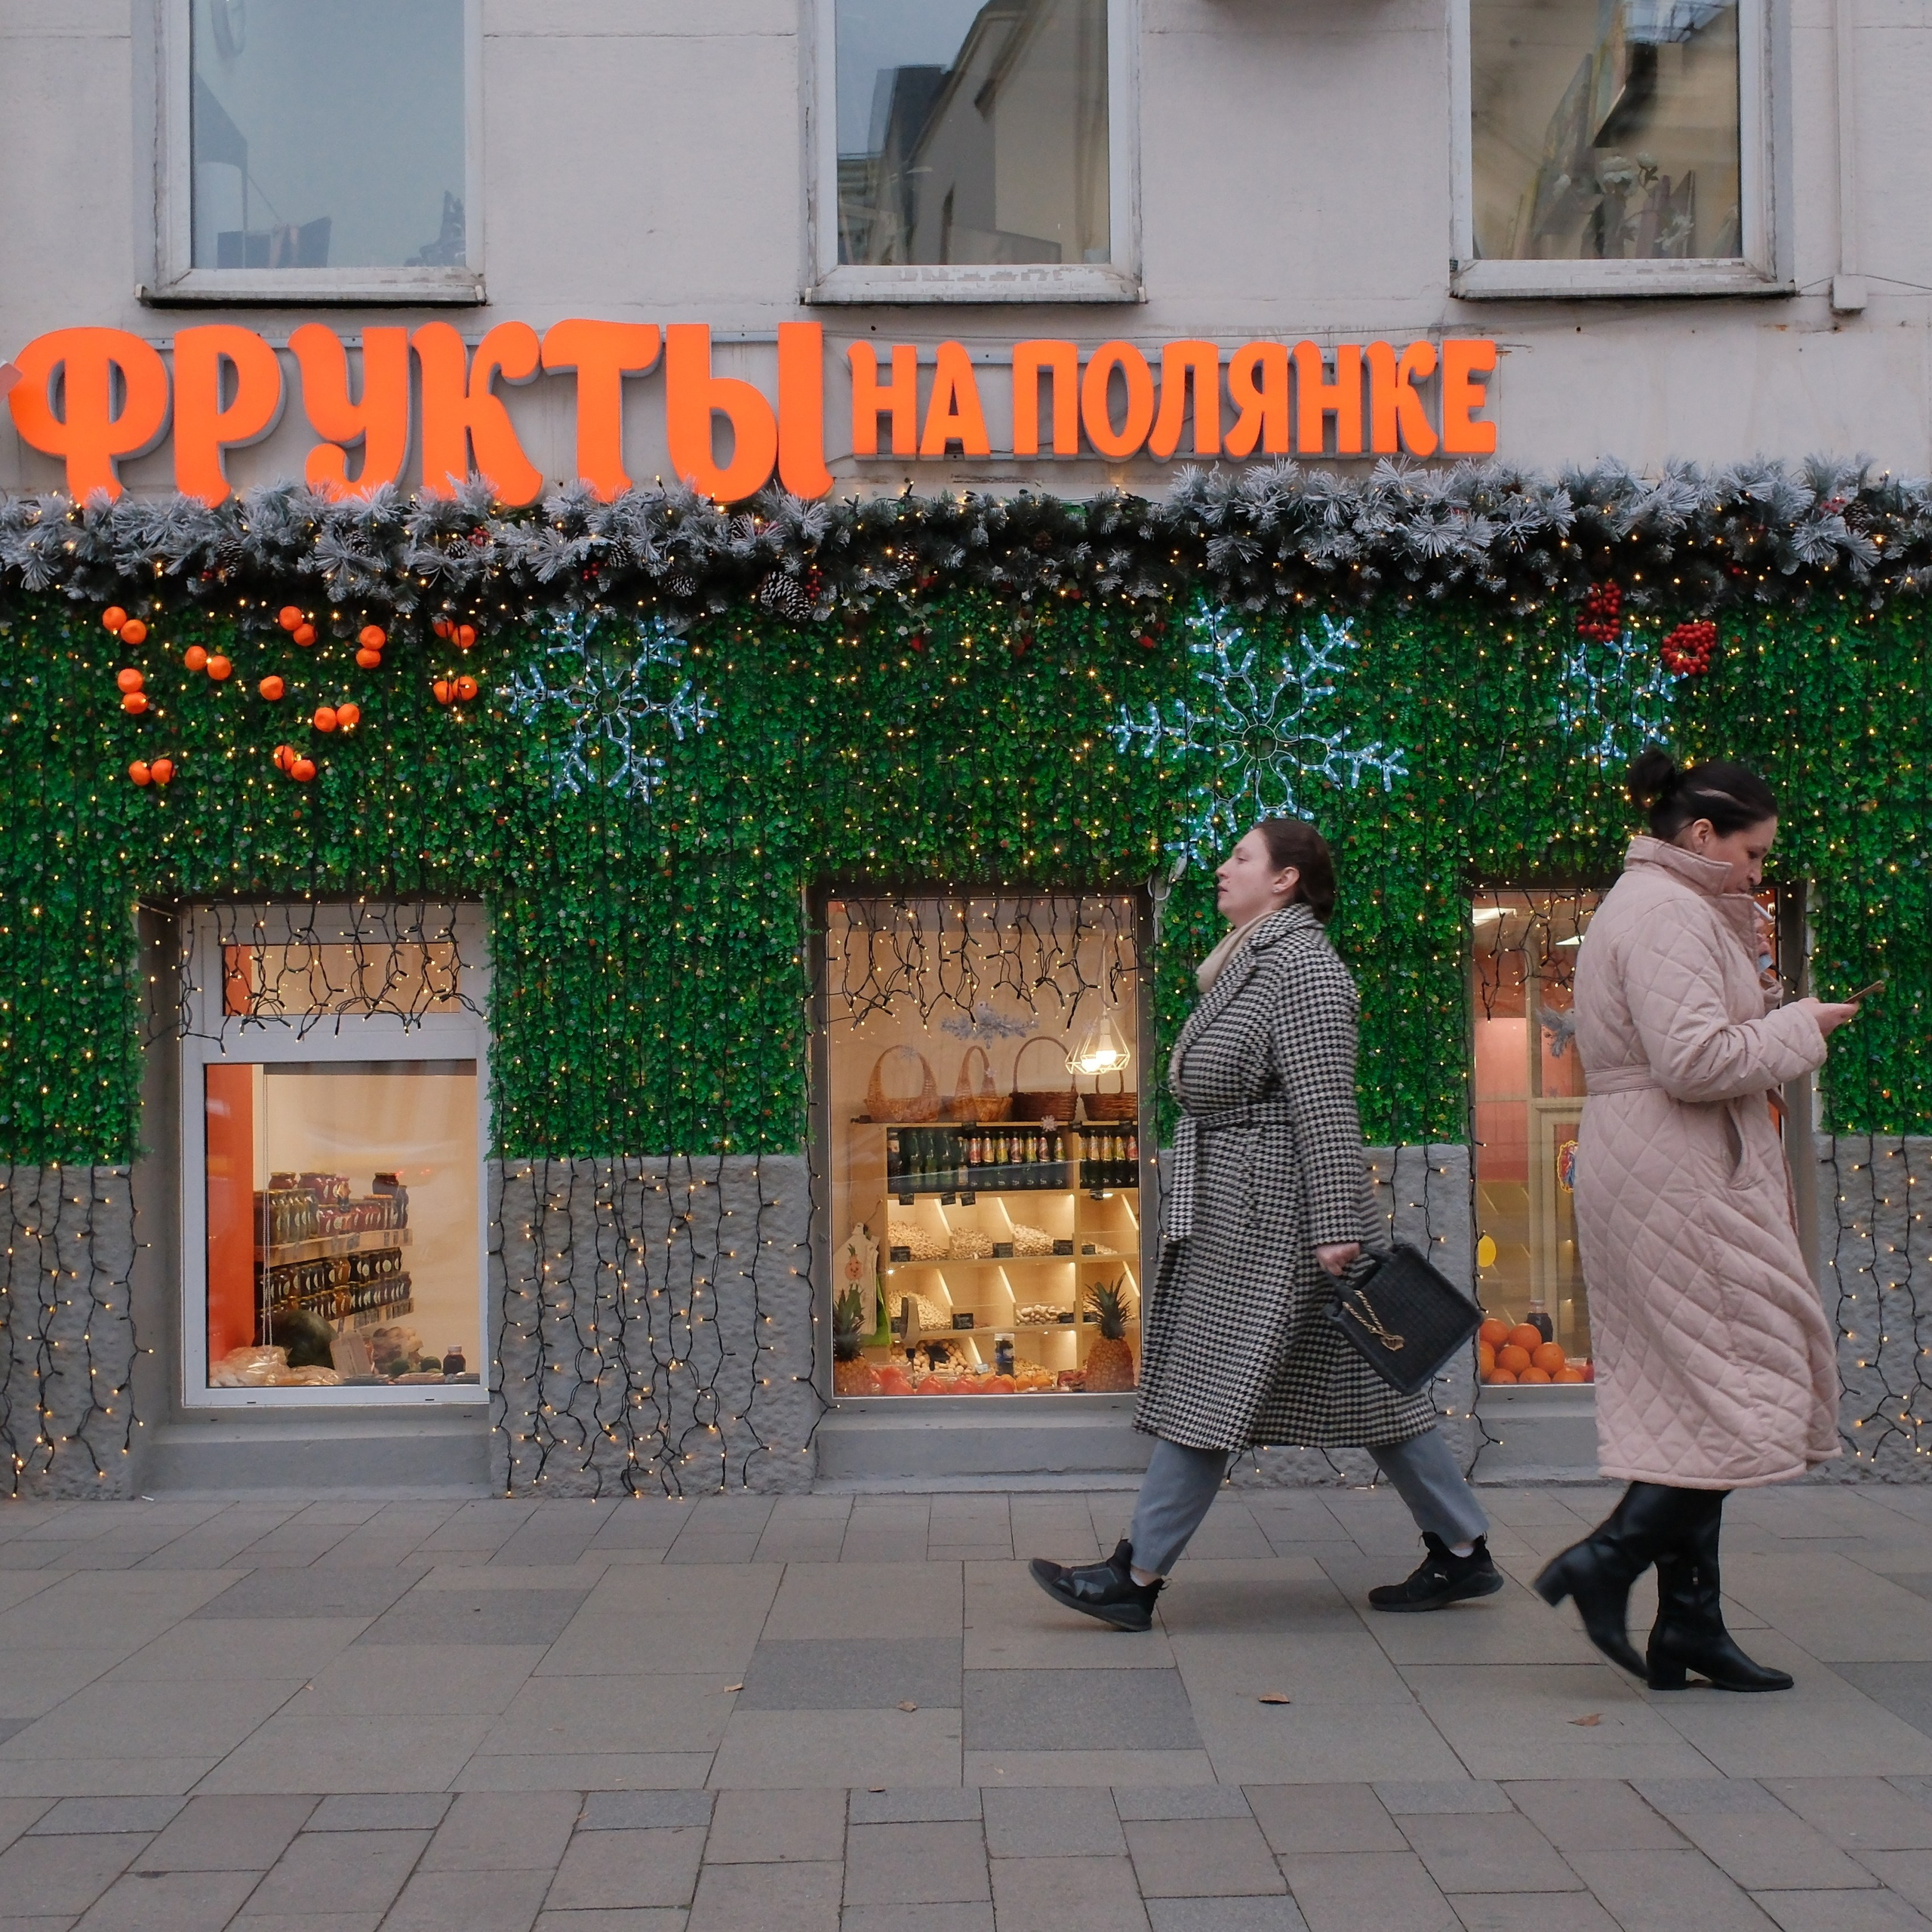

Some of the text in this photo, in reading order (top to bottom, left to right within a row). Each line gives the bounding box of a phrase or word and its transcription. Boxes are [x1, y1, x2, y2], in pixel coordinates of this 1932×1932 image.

[9, 320, 1497, 508] ФРУКТЫ НА ПОЛЯНКЕ
